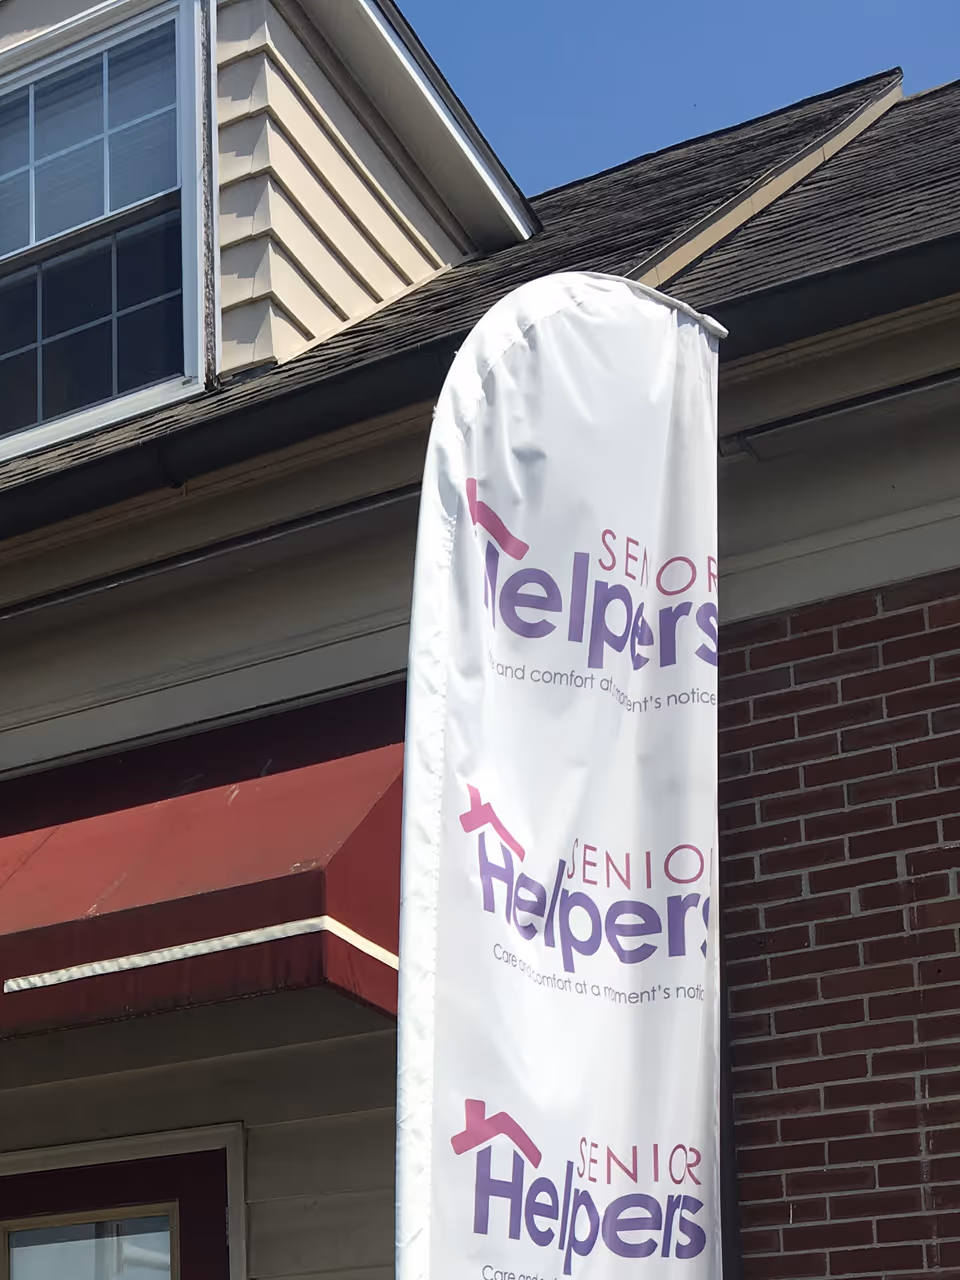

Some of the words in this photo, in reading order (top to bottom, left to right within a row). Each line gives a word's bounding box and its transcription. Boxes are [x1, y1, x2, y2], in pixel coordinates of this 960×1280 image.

[496, 665, 526, 680] and
[530, 670, 596, 689] comfort
[567, 837, 713, 890] SENIO
[478, 831, 710, 973] Helper
[493, 943, 518, 967] Care
[532, 970, 572, 992] comfort
[575, 980, 587, 994] at
[591, 984, 600, 996] a
[577, 1137, 702, 1185] SENIOR
[473, 1145, 707, 1276] Helpers
